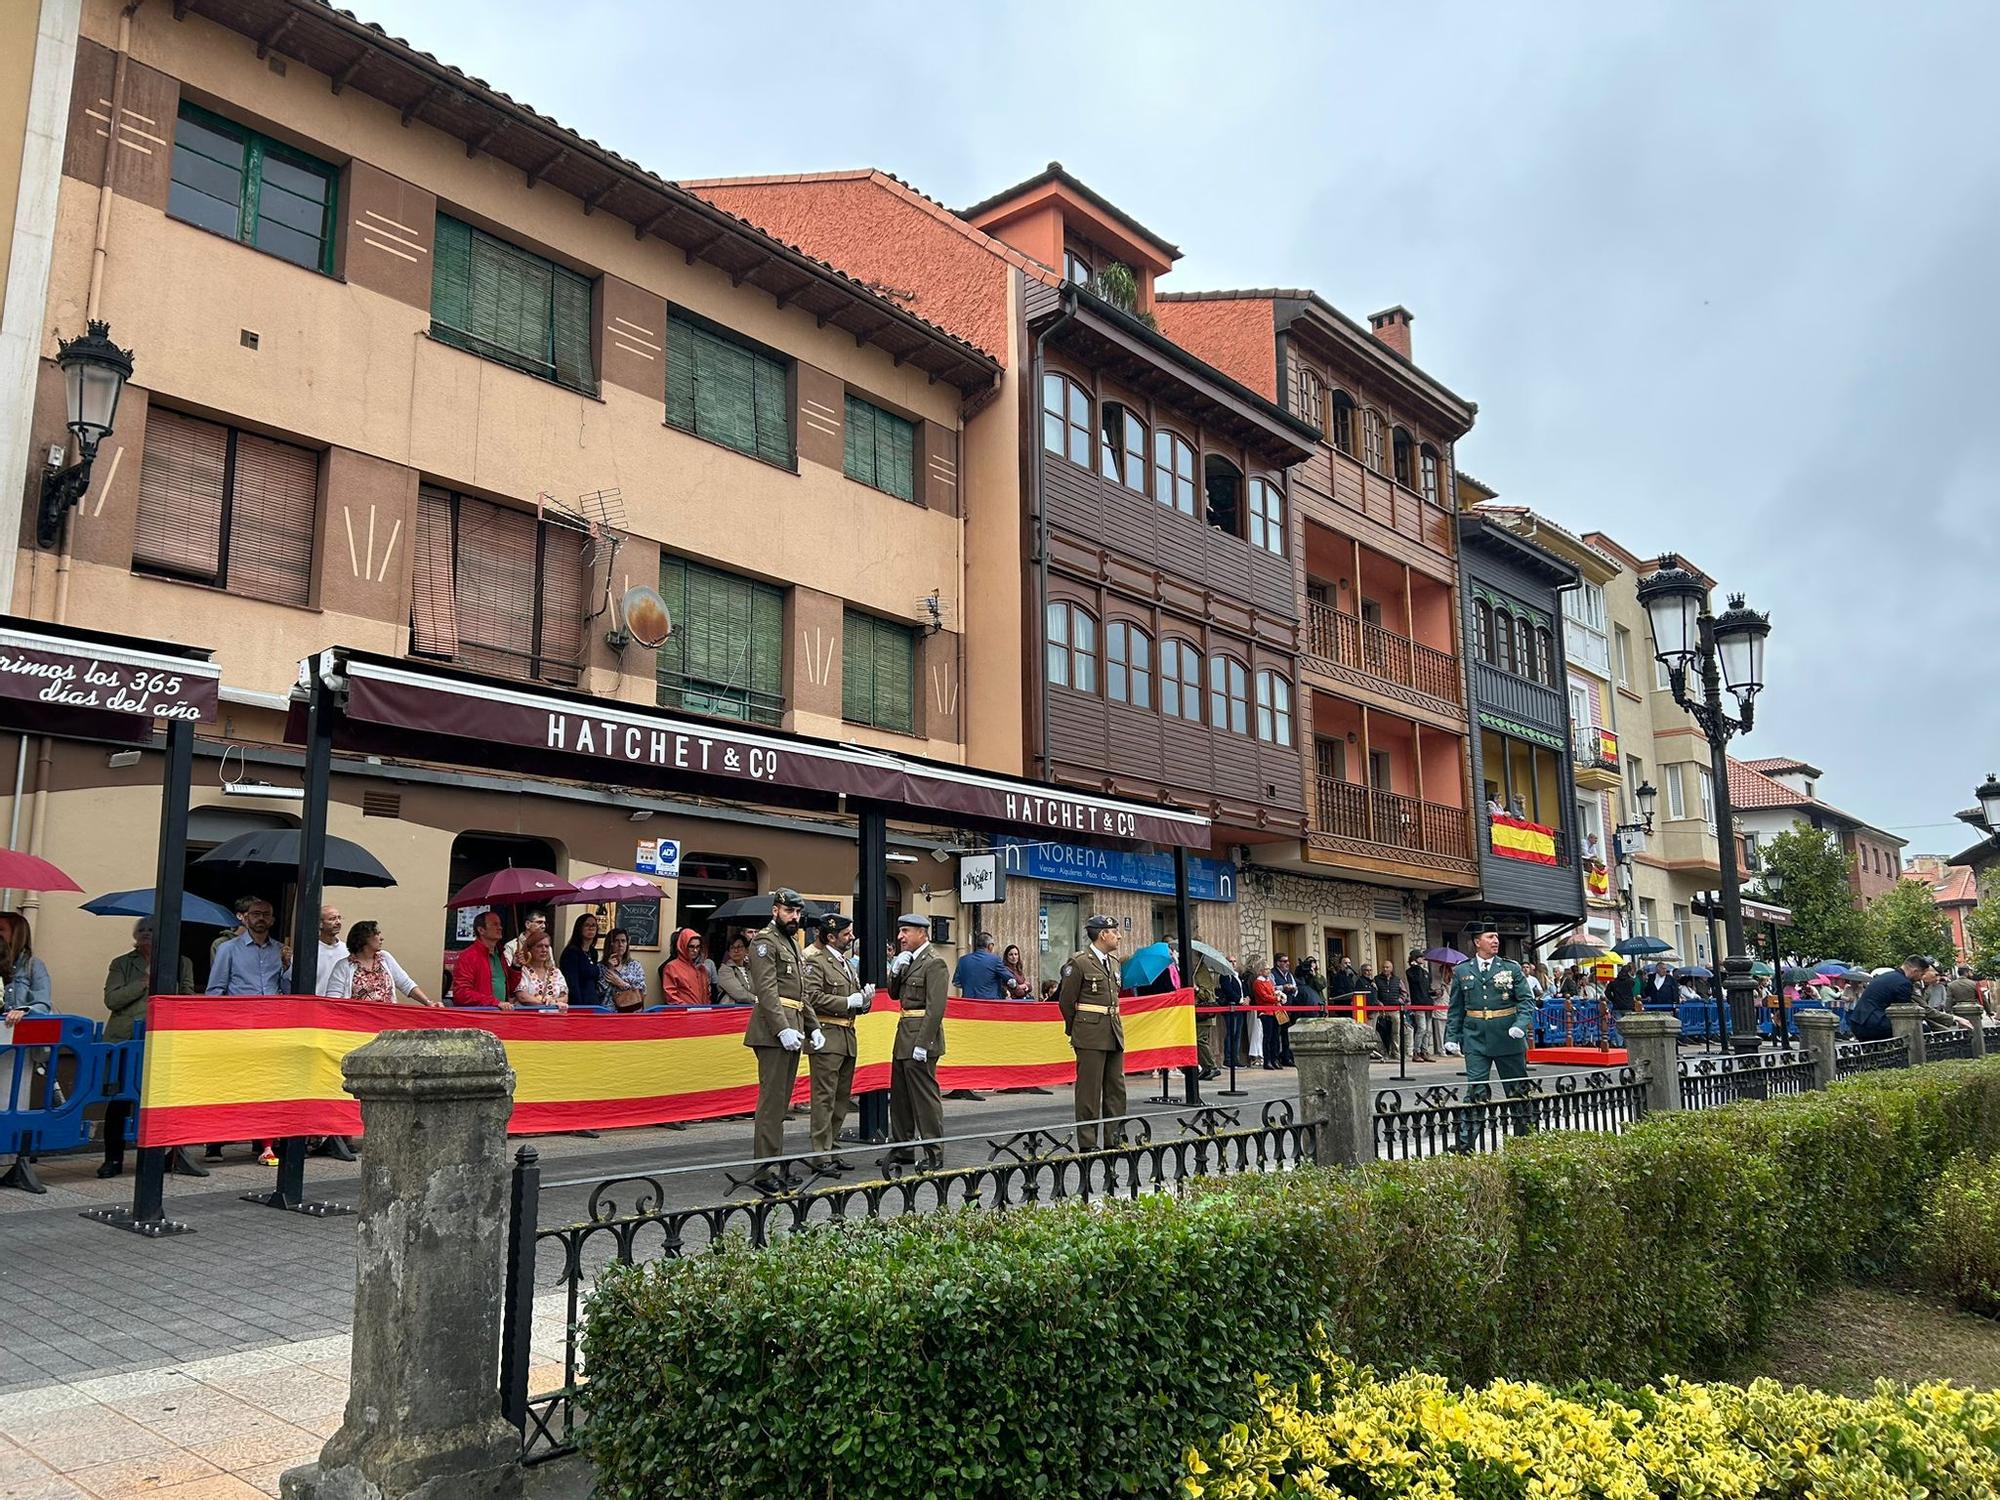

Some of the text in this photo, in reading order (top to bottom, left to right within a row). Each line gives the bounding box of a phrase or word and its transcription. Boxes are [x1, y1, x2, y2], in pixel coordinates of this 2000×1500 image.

[84, 661, 120, 687] los
[130, 672, 182, 695] 365
[39, 678, 201, 720] días del año
[547, 713, 713, 770] HATCHET
[724, 747, 741, 771] &
[1006, 794, 1097, 831] HATCHET
[1103, 812, 1113, 831] &
[962, 869, 992, 886] HATCHET
